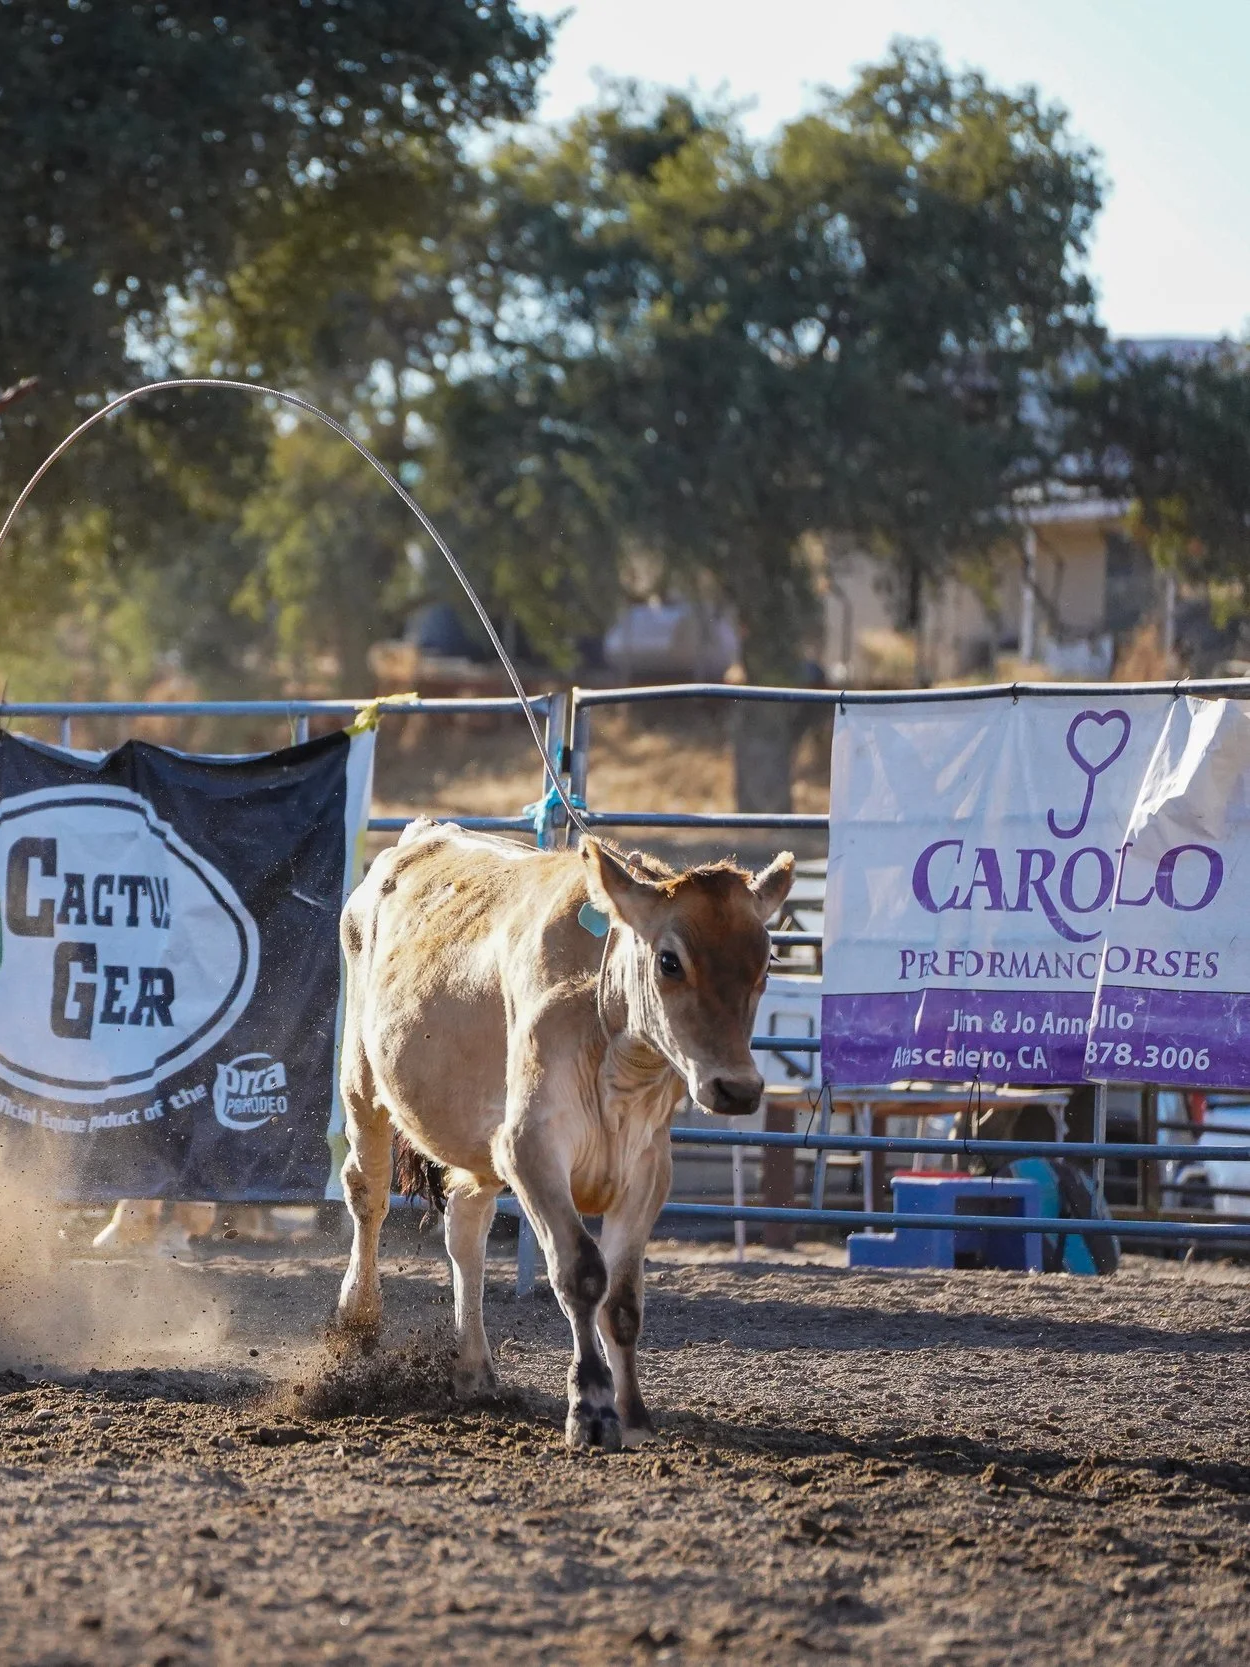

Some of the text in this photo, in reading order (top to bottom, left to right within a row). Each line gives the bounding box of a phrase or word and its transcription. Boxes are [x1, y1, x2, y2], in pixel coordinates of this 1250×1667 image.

[947, 1009, 983, 1033] Jim
[990, 1010, 1008, 1033] &
[1011, 1011, 1036, 1034] Jo
[1017, 1046, 1048, 1070] CA
[144, 1100, 164, 1121] of
[168, 1084, 208, 1110] the
